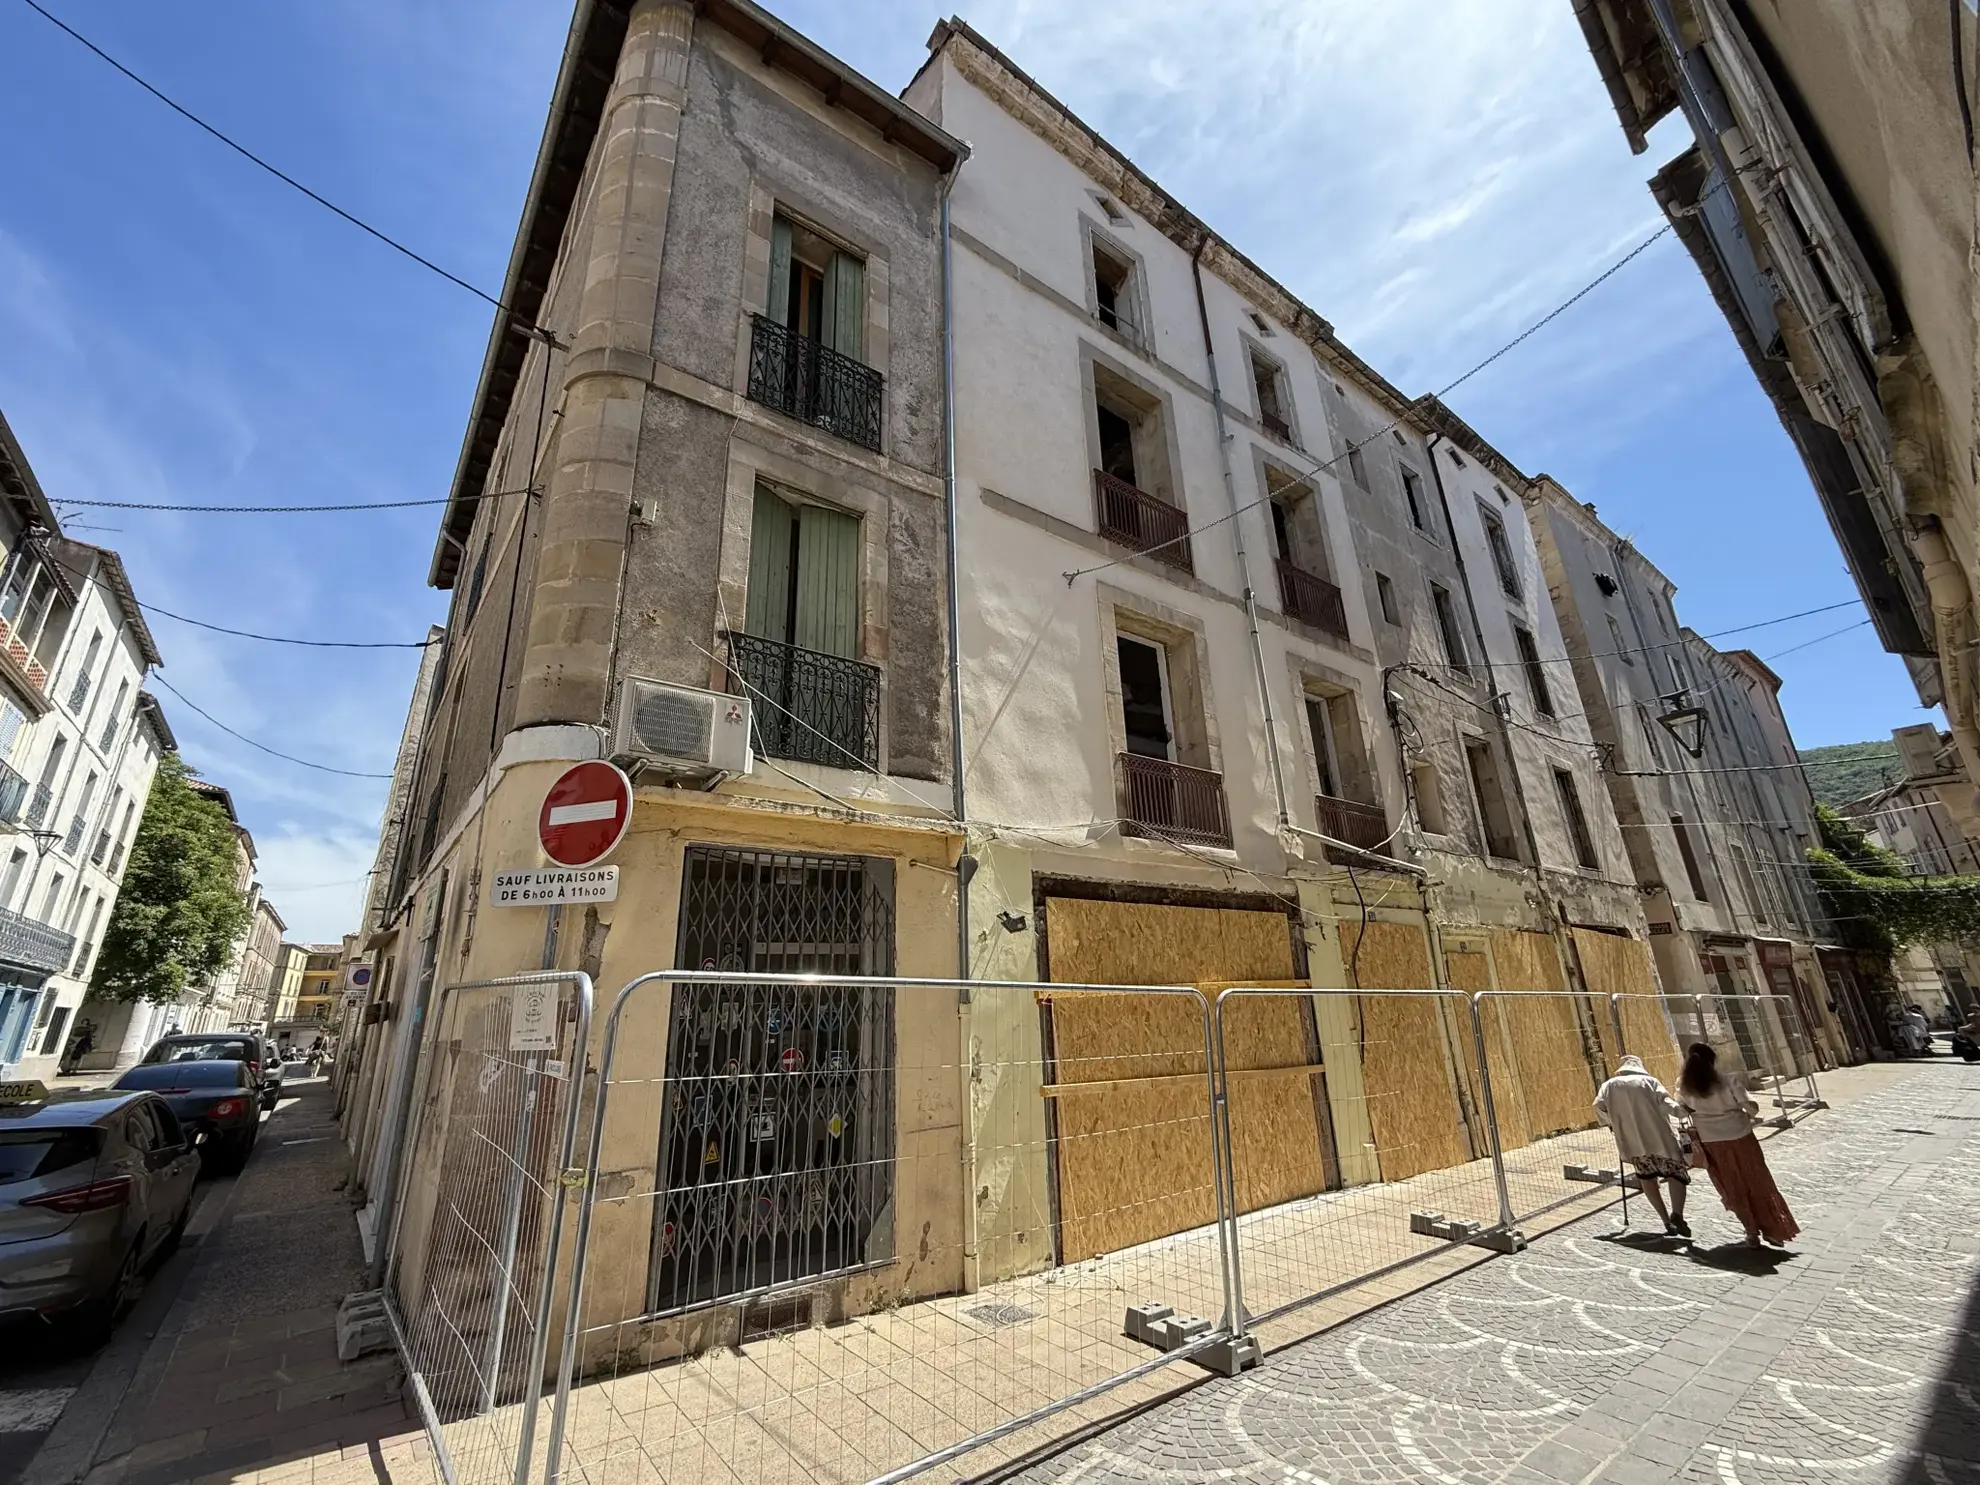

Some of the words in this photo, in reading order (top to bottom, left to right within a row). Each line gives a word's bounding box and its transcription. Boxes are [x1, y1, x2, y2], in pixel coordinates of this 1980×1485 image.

[496, 874, 532, 887] SAUF
[535, 871, 614, 885] LIVRAISONS
[501, 890, 518, 901] DE
[522, 889, 554, 899] 6h00
[557, 885, 566, 898] À
[571, 887, 606, 897] 11h00
